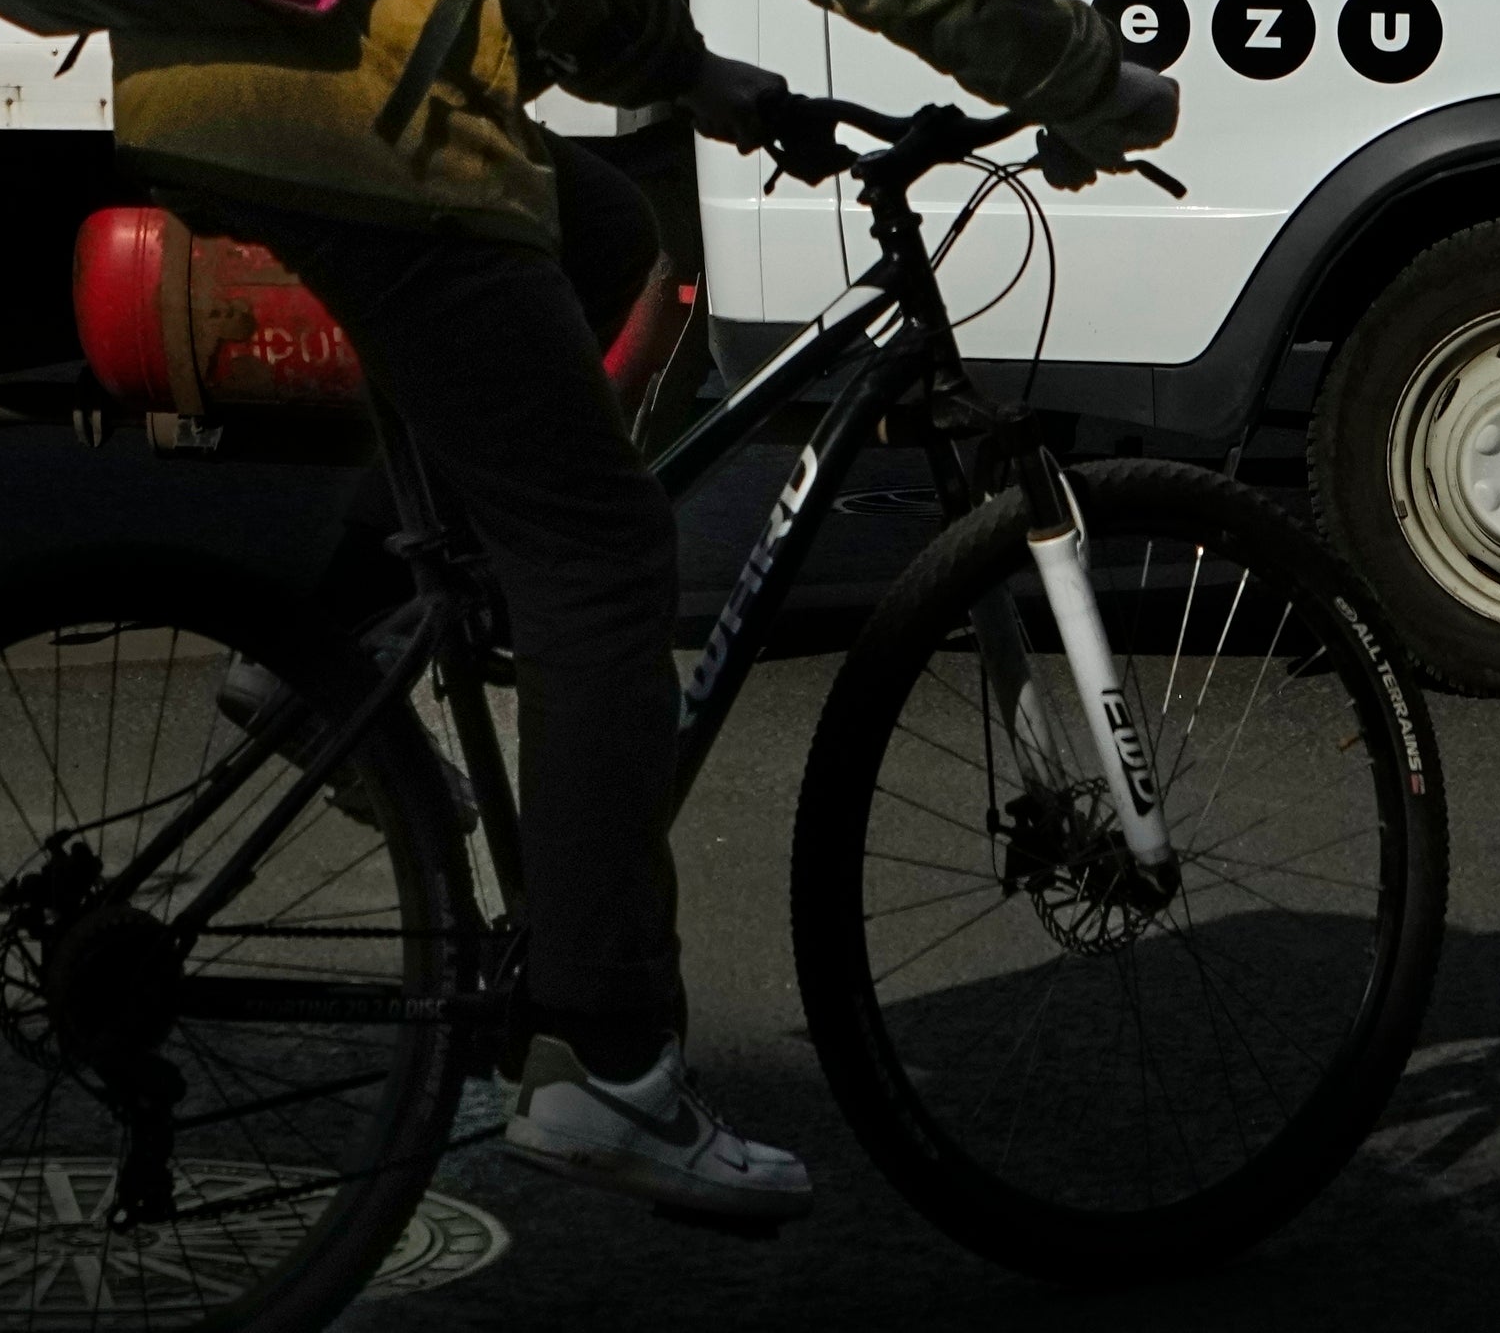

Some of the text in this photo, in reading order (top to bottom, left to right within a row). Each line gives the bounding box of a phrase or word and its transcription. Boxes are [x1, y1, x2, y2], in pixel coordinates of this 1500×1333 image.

[1119, 4, 1412, 54] ezu
[1351, 621, 1424, 773] ALL TERRAINS
[404, 997, 449, 1021] DISC
